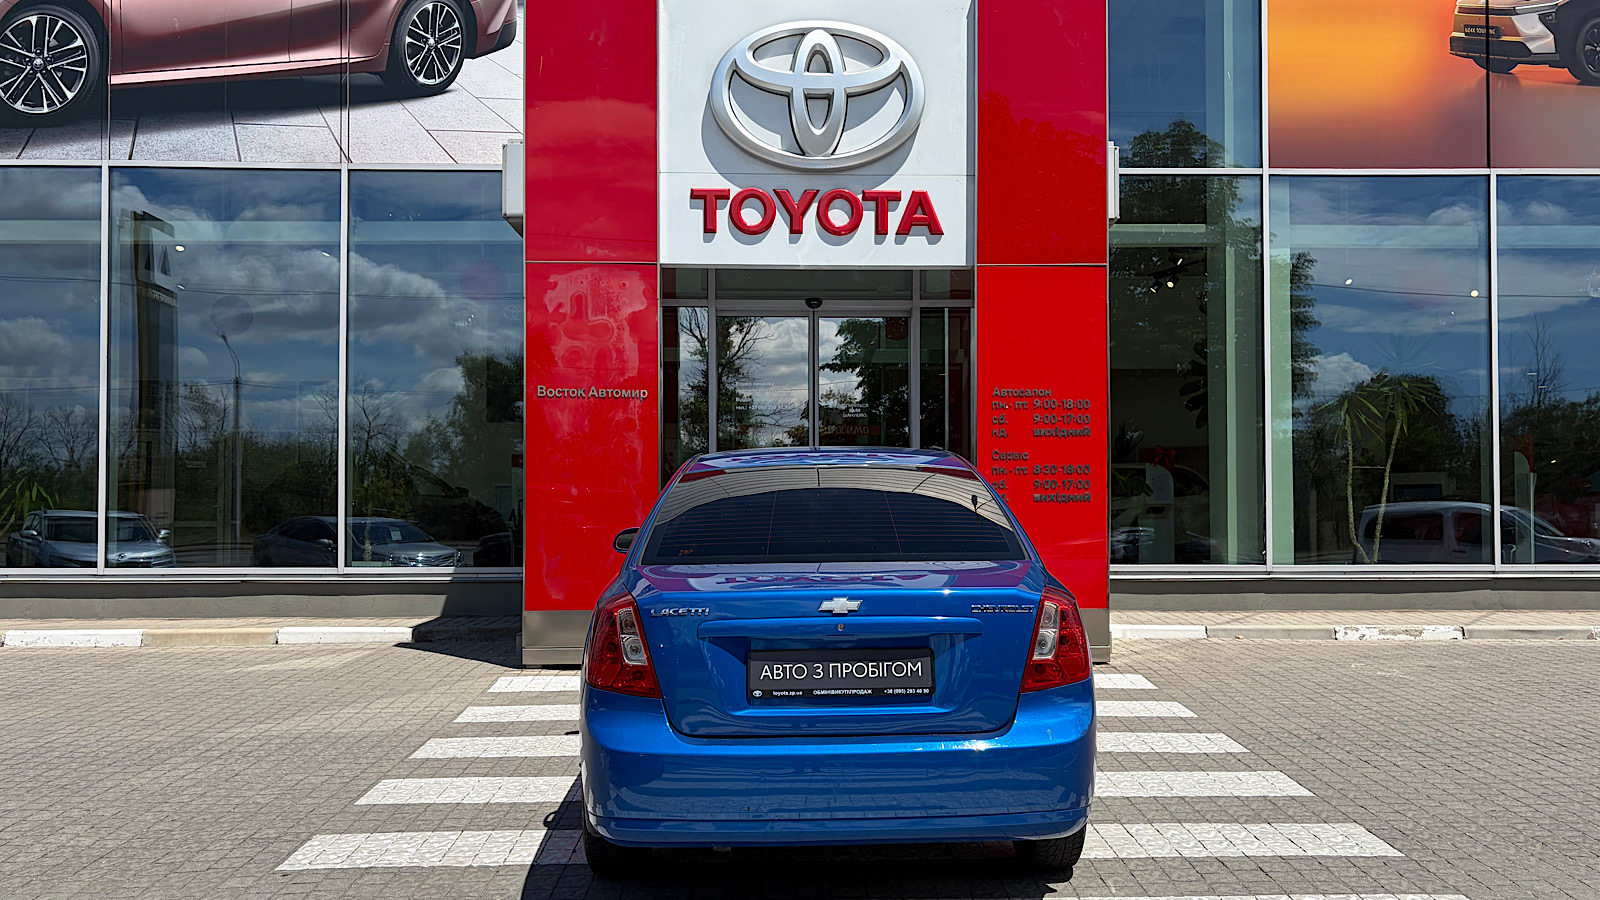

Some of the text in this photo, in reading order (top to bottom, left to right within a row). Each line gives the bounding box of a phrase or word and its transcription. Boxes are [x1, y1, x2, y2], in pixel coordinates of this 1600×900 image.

[690, 188, 944, 236] TOYOTA
[537, 385, 648, 402] Восток Автомир
[993, 387, 1052, 397] Автосалон
[1034, 399, 1090, 409] 9:00-18:00
[993, 414, 1090, 424] сб. 9:00-17:00
[992, 426, 1090, 437] нд. вихідний
[992, 450, 1029, 462] Сервіс
[1034, 465, 1090, 474] 8:30-18:00
[1034, 479, 1090, 489] 9:00-17:00
[1034, 491, 1091, 502] вихідний
[651, 607, 709, 616] LACETTI
[972, 604, 1035, 613] CHEVROLET
[760, 664, 808, 680] АВТО
[829, 661, 922, 678] ПРОБІГОМ
